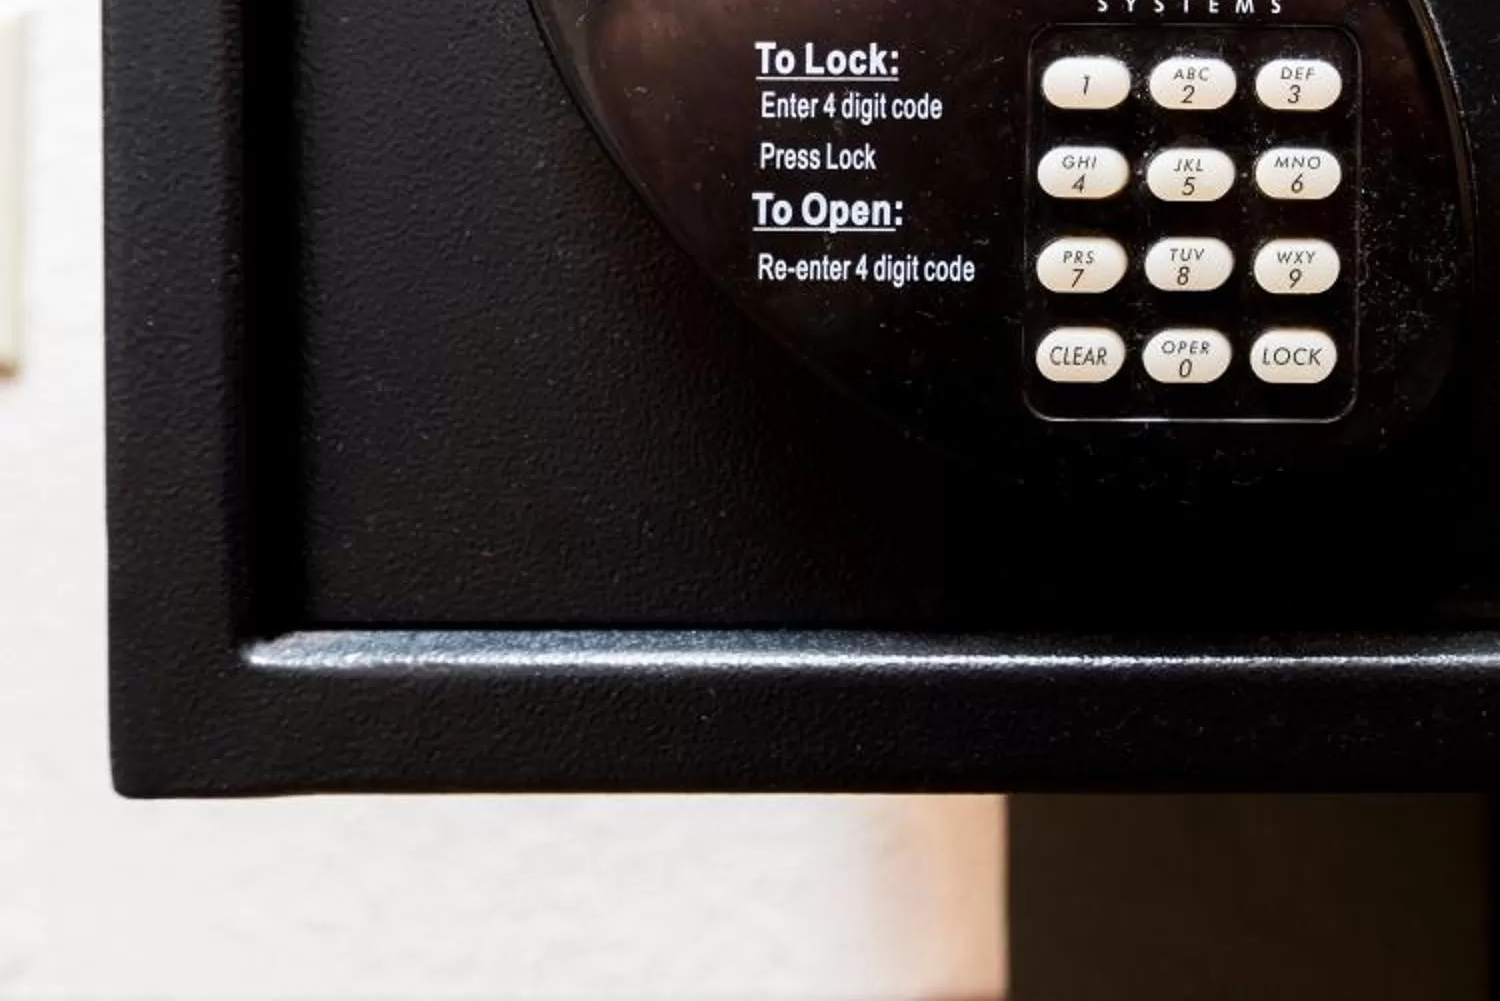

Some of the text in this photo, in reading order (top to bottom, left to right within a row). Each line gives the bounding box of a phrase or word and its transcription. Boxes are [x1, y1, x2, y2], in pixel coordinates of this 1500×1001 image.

[754, 41, 899, 76] To Lock:
[1174, 67, 1209, 81] ABC
[1280, 67, 1316, 81] DEF
[1082, 75, 1090, 95] 1
[1181, 85, 1195, 104] 2
[1288, 85, 1301, 104] 3
[761, 91, 943, 126] Enter 4 digit code
[760, 143, 877, 170] Press Lock
[1062, 155, 1097, 170] GHI
[1174, 158, 1204, 173] JKL
[1274, 156, 1321, 170] MNO
[1071, 175, 1085, 193] 4
[1181, 177, 1195, 196] 5
[1291, 175, 1303, 193] 6
[751, 191, 903, 234] To Open:
[1063, 250, 1095, 264] PRS
[1169, 248, 1205, 262] TUV
[1276, 251, 1316, 264] WXY
[758, 253, 975, 288] Re-enter 4 digit code
[1071, 268, 1085, 288] 7
[1176, 266, 1190, 286] 8
[1289, 269, 1302, 289] 9
[1050, 346, 1107, 366] CLEAR
[1161, 340, 1210, 354] OPER
[1261, 348, 1322, 366] LOCK
[1178, 358, 1193, 378] 0
